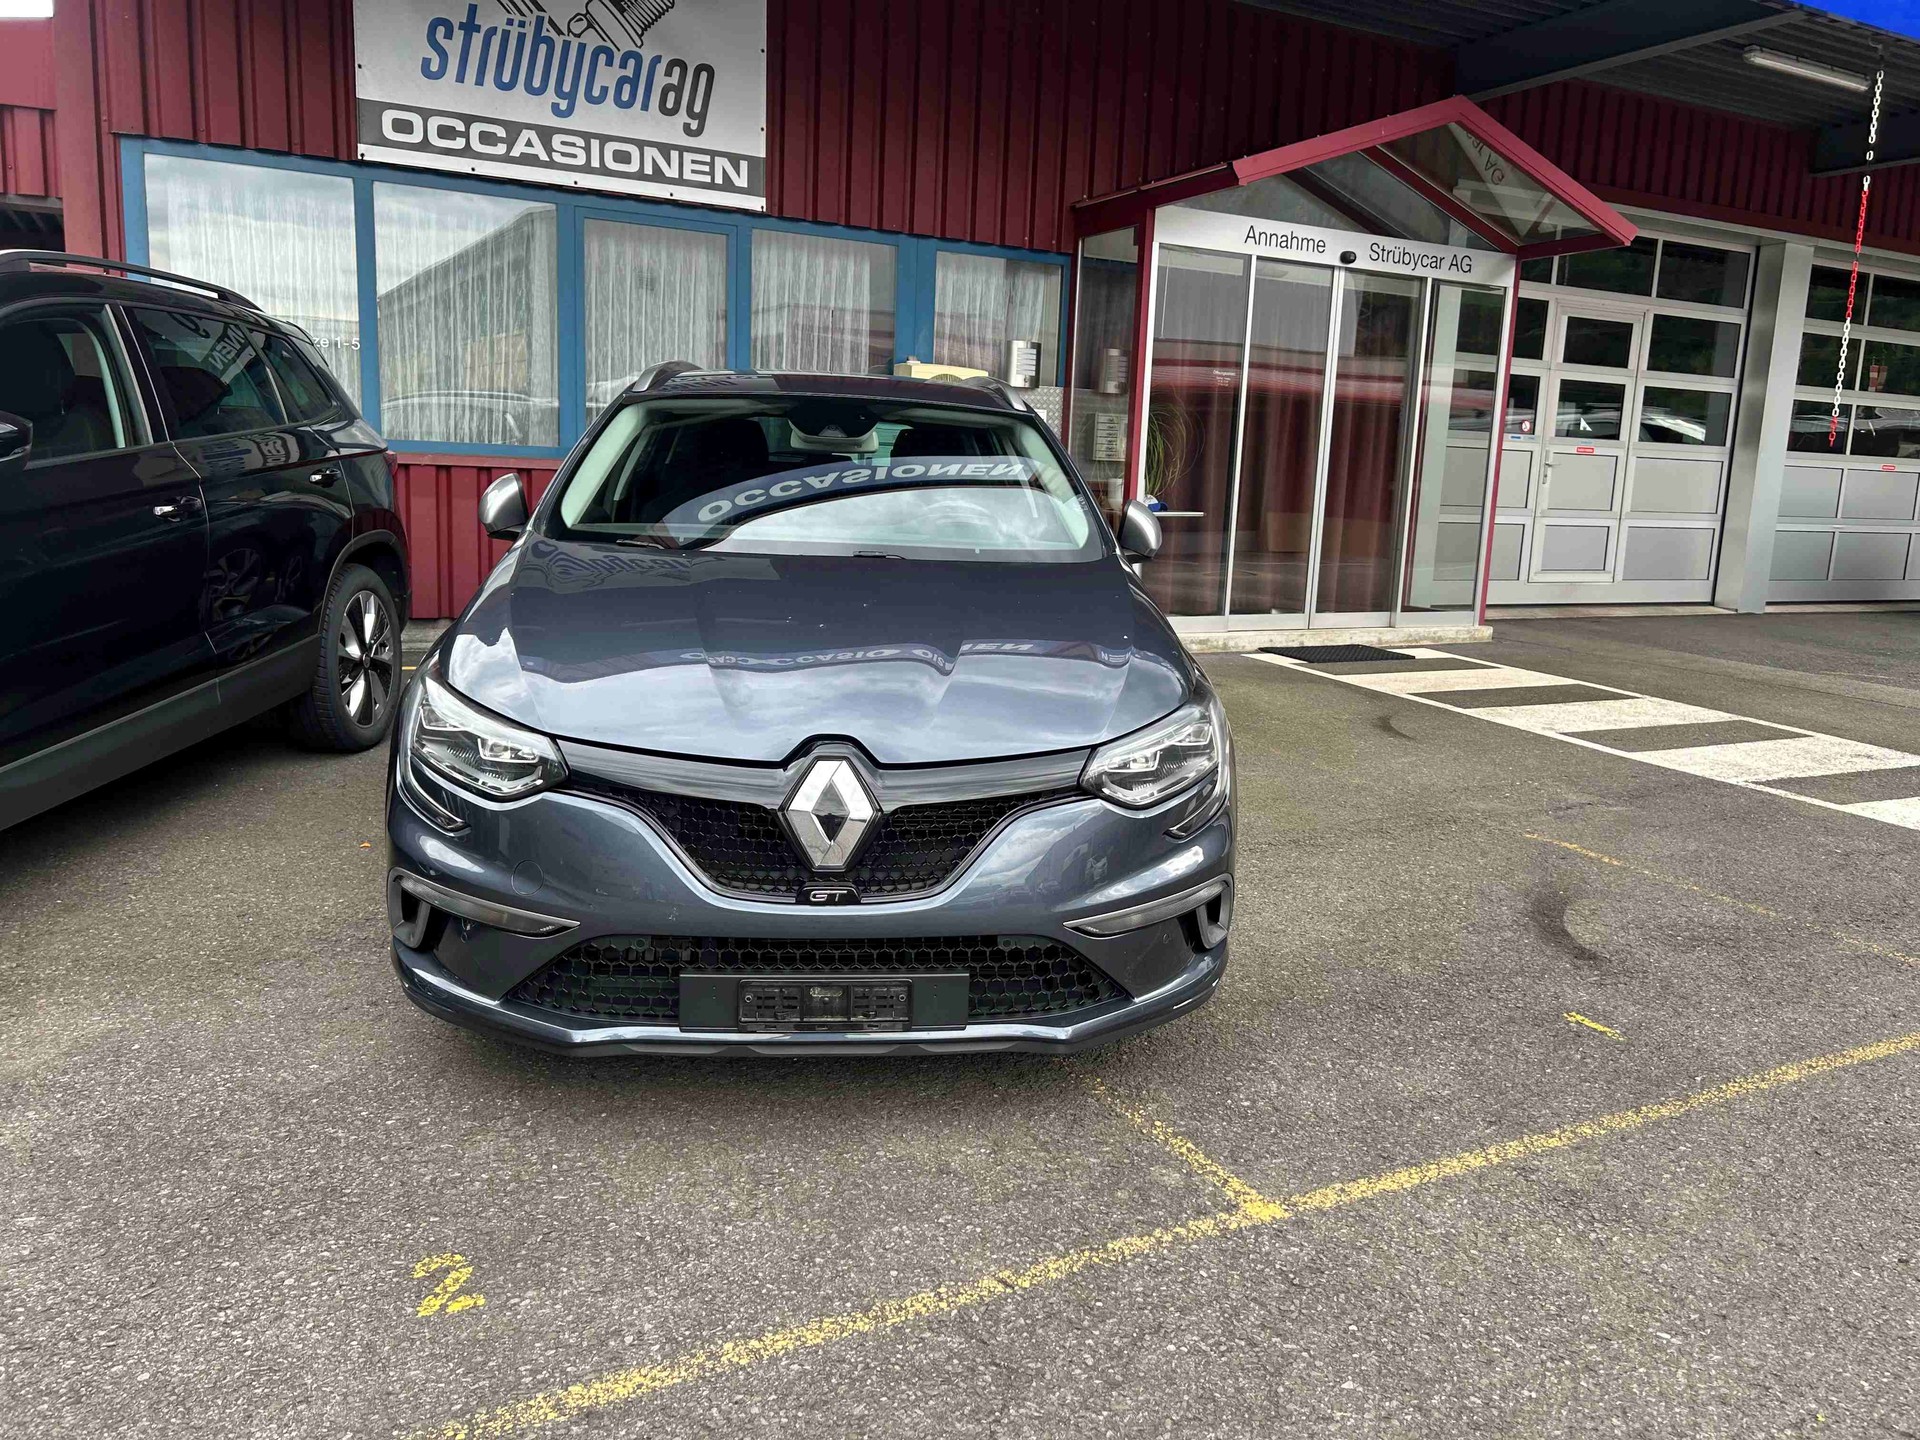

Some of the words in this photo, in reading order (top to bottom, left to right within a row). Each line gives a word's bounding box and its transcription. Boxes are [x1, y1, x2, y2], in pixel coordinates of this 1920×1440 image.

[381, 109, 749, 189] OCCASIONEN
[1244, 225, 1326, 254] Annahme
[1369, 242, 1445, 271] Strübycar
[1448, 253, 1473, 273] AG
[334, 336, 361, 351] 1-5
[809, 889, 848, 902] GT
[411, 1253, 487, 1318] 2
